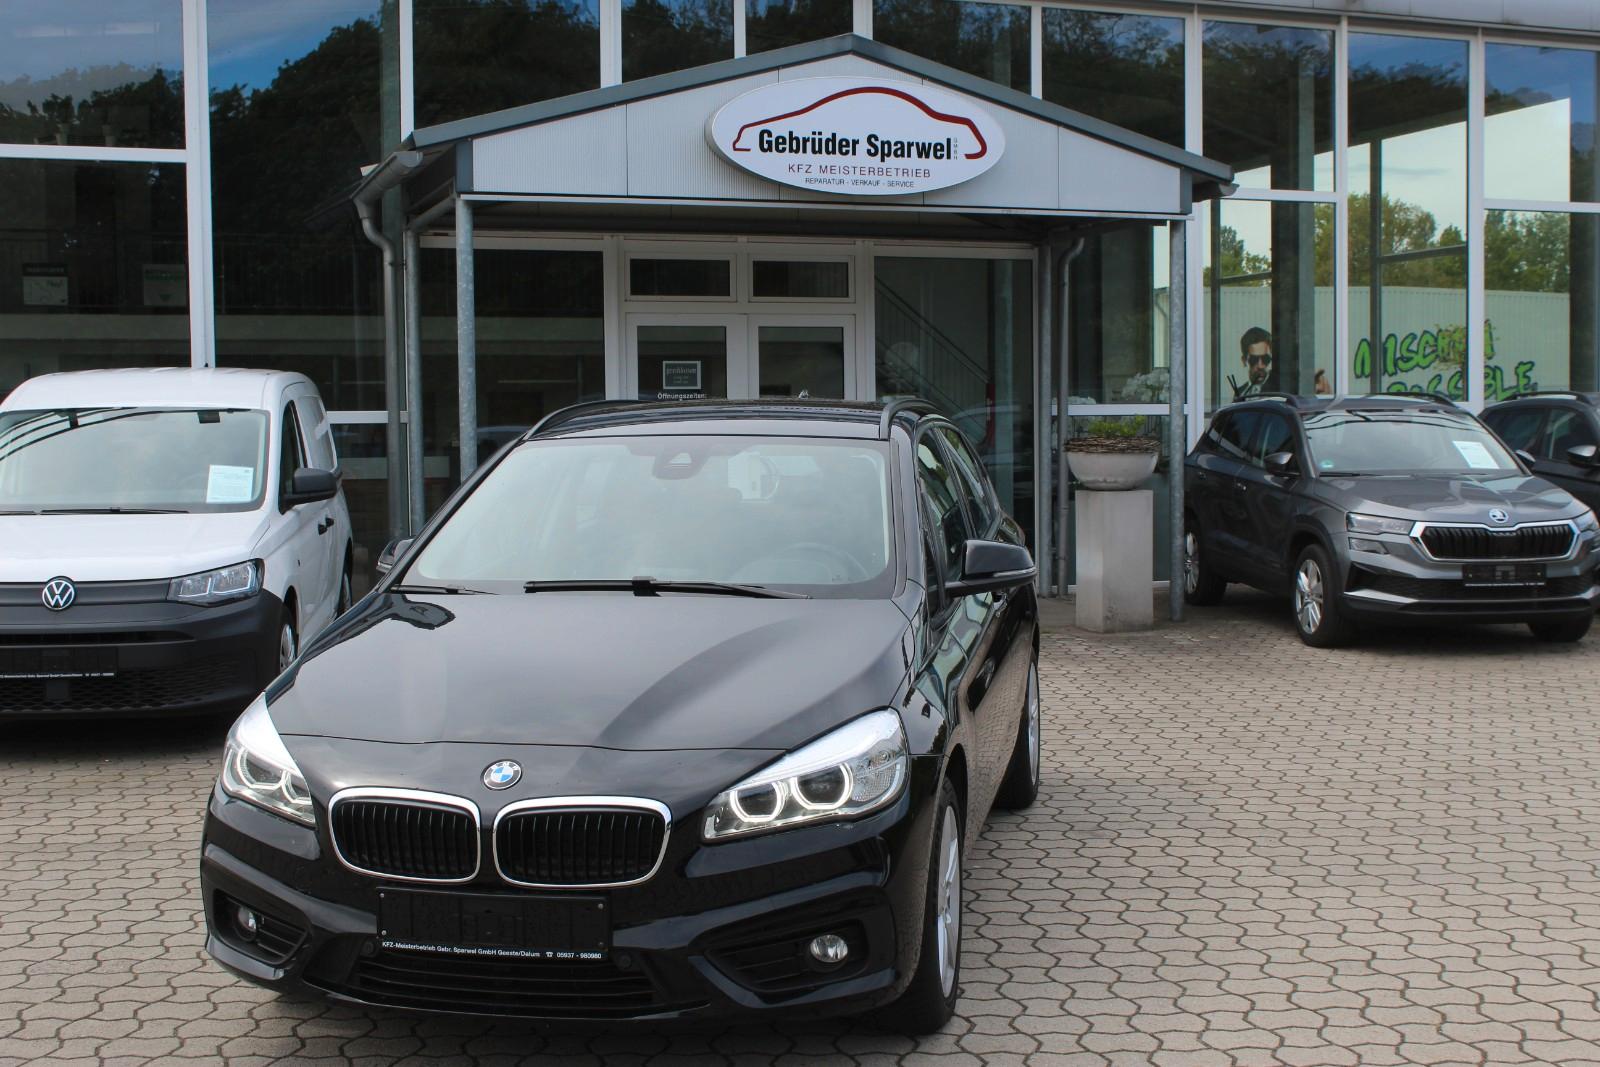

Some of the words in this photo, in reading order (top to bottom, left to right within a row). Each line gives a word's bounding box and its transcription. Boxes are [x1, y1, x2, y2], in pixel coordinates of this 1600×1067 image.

[758, 129, 860, 156] Gebrüder
[866, 133, 952, 163] Sparwel
[788, 164, 813, 173] KFZ
[819, 165, 932, 178] MEISTERBETRIEB
[805, 177, 845, 185] REPARATUR
[851, 179, 881, 187] VERKAUF
